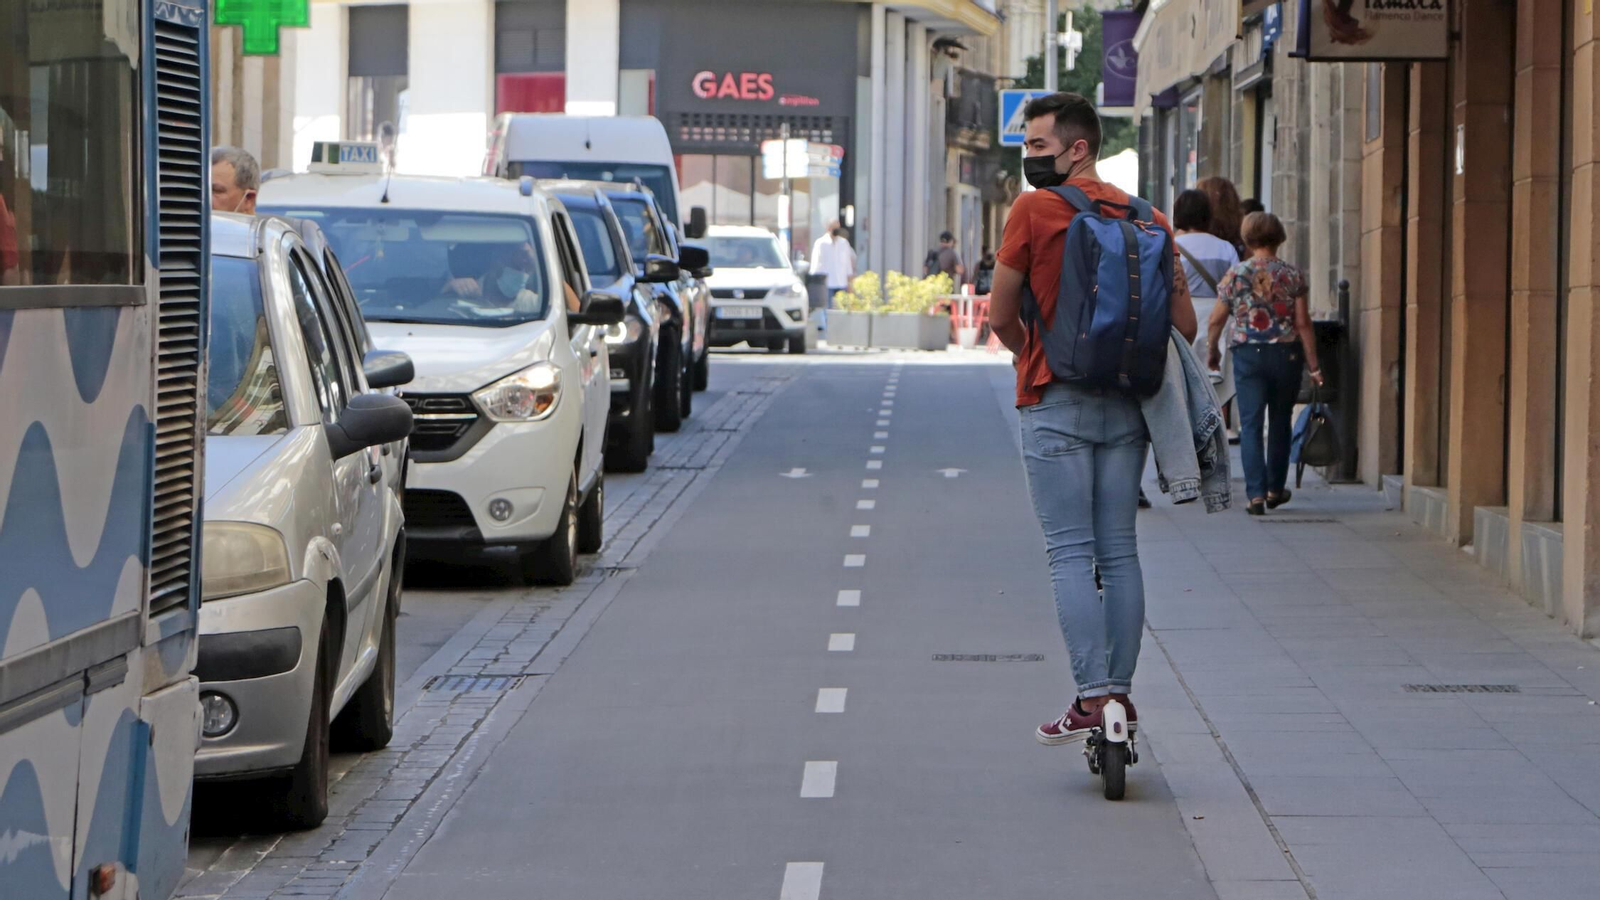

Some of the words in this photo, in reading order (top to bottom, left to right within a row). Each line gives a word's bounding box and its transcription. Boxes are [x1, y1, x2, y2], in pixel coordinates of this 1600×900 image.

[1364, 10, 1411, 21] Flamenco
[1413, 10, 1445, 21] Dance
[691, 70, 775, 100] GAES
[341, 146, 377, 162] TAXI
